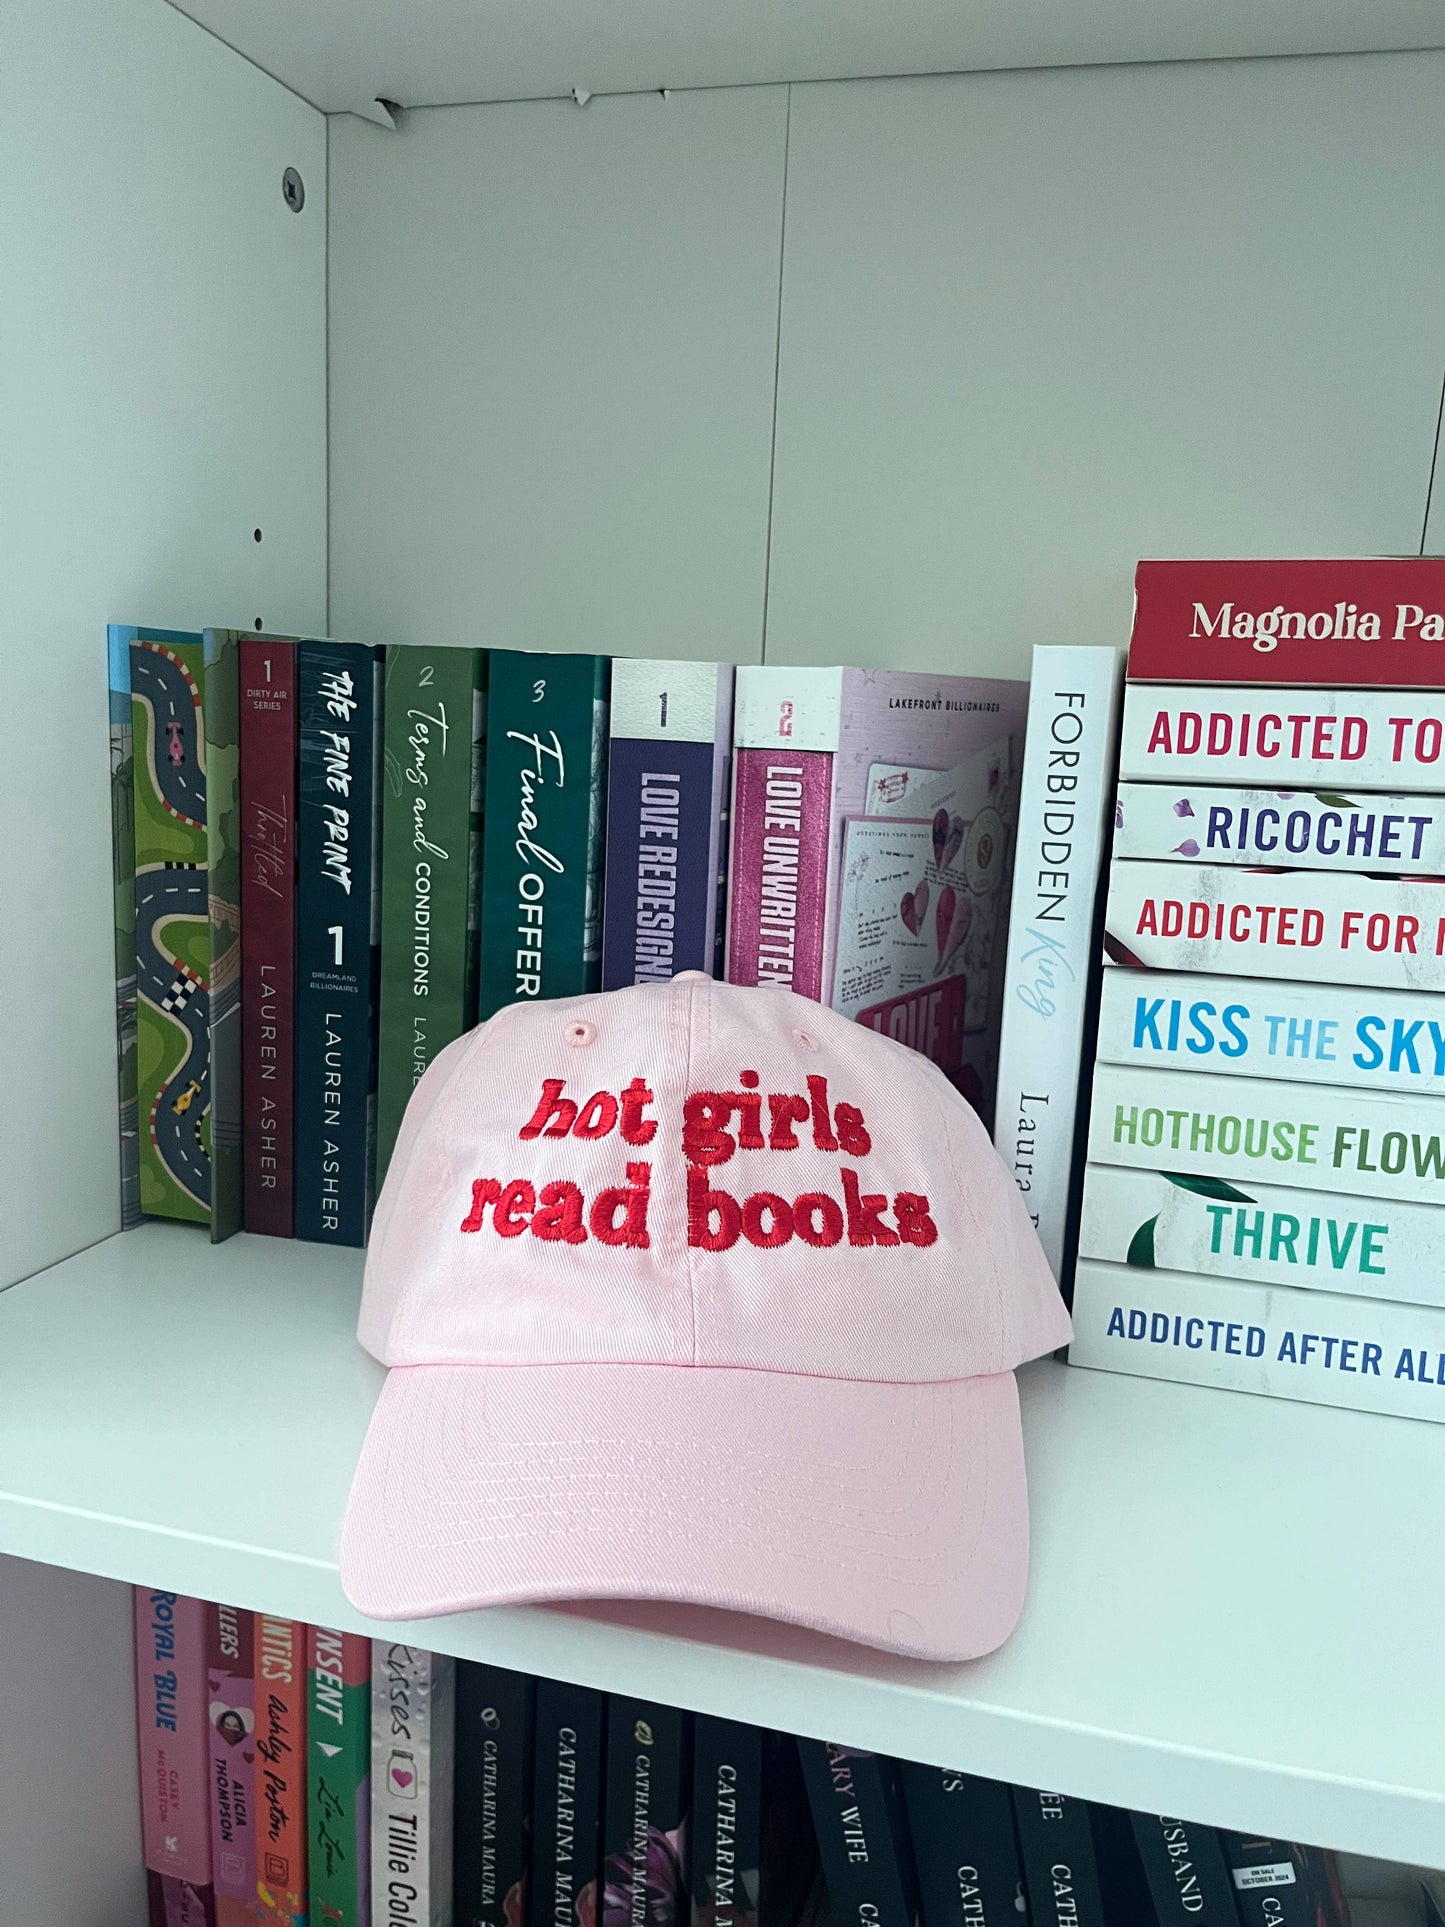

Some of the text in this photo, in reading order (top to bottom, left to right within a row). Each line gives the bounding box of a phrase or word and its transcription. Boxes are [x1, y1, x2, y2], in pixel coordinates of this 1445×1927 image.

[1188, 601, 1381, 653] Magnolia
[246, 689, 287, 699] DIRTY AIR
[263, 659, 273, 683] 1
[417, 665, 435, 688] 2
[531, 679, 546, 703] 3
[888, 698, 1000, 713] LAKEFRONT BILLIONAIRES
[253, 701, 281, 711] SERIES
[659, 691, 668, 728] 1
[1147, 710, 1443, 765] ADDICTED TO
[406, 702, 450, 790] Terms
[317, 670, 357, 896] THE FINE PRINT
[639, 772, 681, 841] LOVE
[249, 794, 288, 898] Throttled
[412, 797, 449, 860] and
[1206, 806, 1433, 860] RICOCHET
[506, 730, 565, 997] Final OFFER
[757, 765, 803, 992] LOVE UNWRITTEN
[327, 925, 343, 966] 1
[413, 862, 431, 997] CONDITIONS
[1014, 691, 1086, 1192] FORBIDDEN King Laura
[1136, 898, 1325, 948] ADDICTED
[1340, 911, 1420, 955] FOR
[309, 982, 359, 993] BILLIONAIRES
[311, 971, 357, 983] DREAMLAND
[1132, 996, 1251, 1058] KISS
[1264, 1015, 1339, 1061] THE
[260, 965, 277, 1189] LAUREN ASHER
[322, 1013, 342, 1231] LAUREN ASHER
[518, 1069, 872, 1167] hot girls
[1112, 1104, 1320, 1165] HOTHOUSE
[460, 1161, 938, 1253] read books
[1205, 1204, 1389, 1276] THRIVE
[1106, 1306, 1266, 1359] ADDICTED
[1276, 1330, 1383, 1377] AFTER
[150, 1589, 178, 1732] ROYAL BLUE
[316, 1626, 344, 1726] NSENT
[256, 1693, 293, 1764] Ashley
[215, 1758, 234, 1843] THOMPSON
[232, 1780, 247, 1826] ALICIA
[263, 1769, 290, 1843] Poston
[482, 1740, 498, 1840] CATHARINA
[556, 1727, 577, 1863] CATHARINA
[633, 1754, 651, 1861] CATHARINA
[388, 1814, 418, 1874] Tillie
[715, 1763, 738, 1907] CATHARINA
[840, 1805, 869, 1863] WIFE
[481, 1845, 497, 1905] MAURA
[1241, 1876, 1274, 1886] OCTOBER
